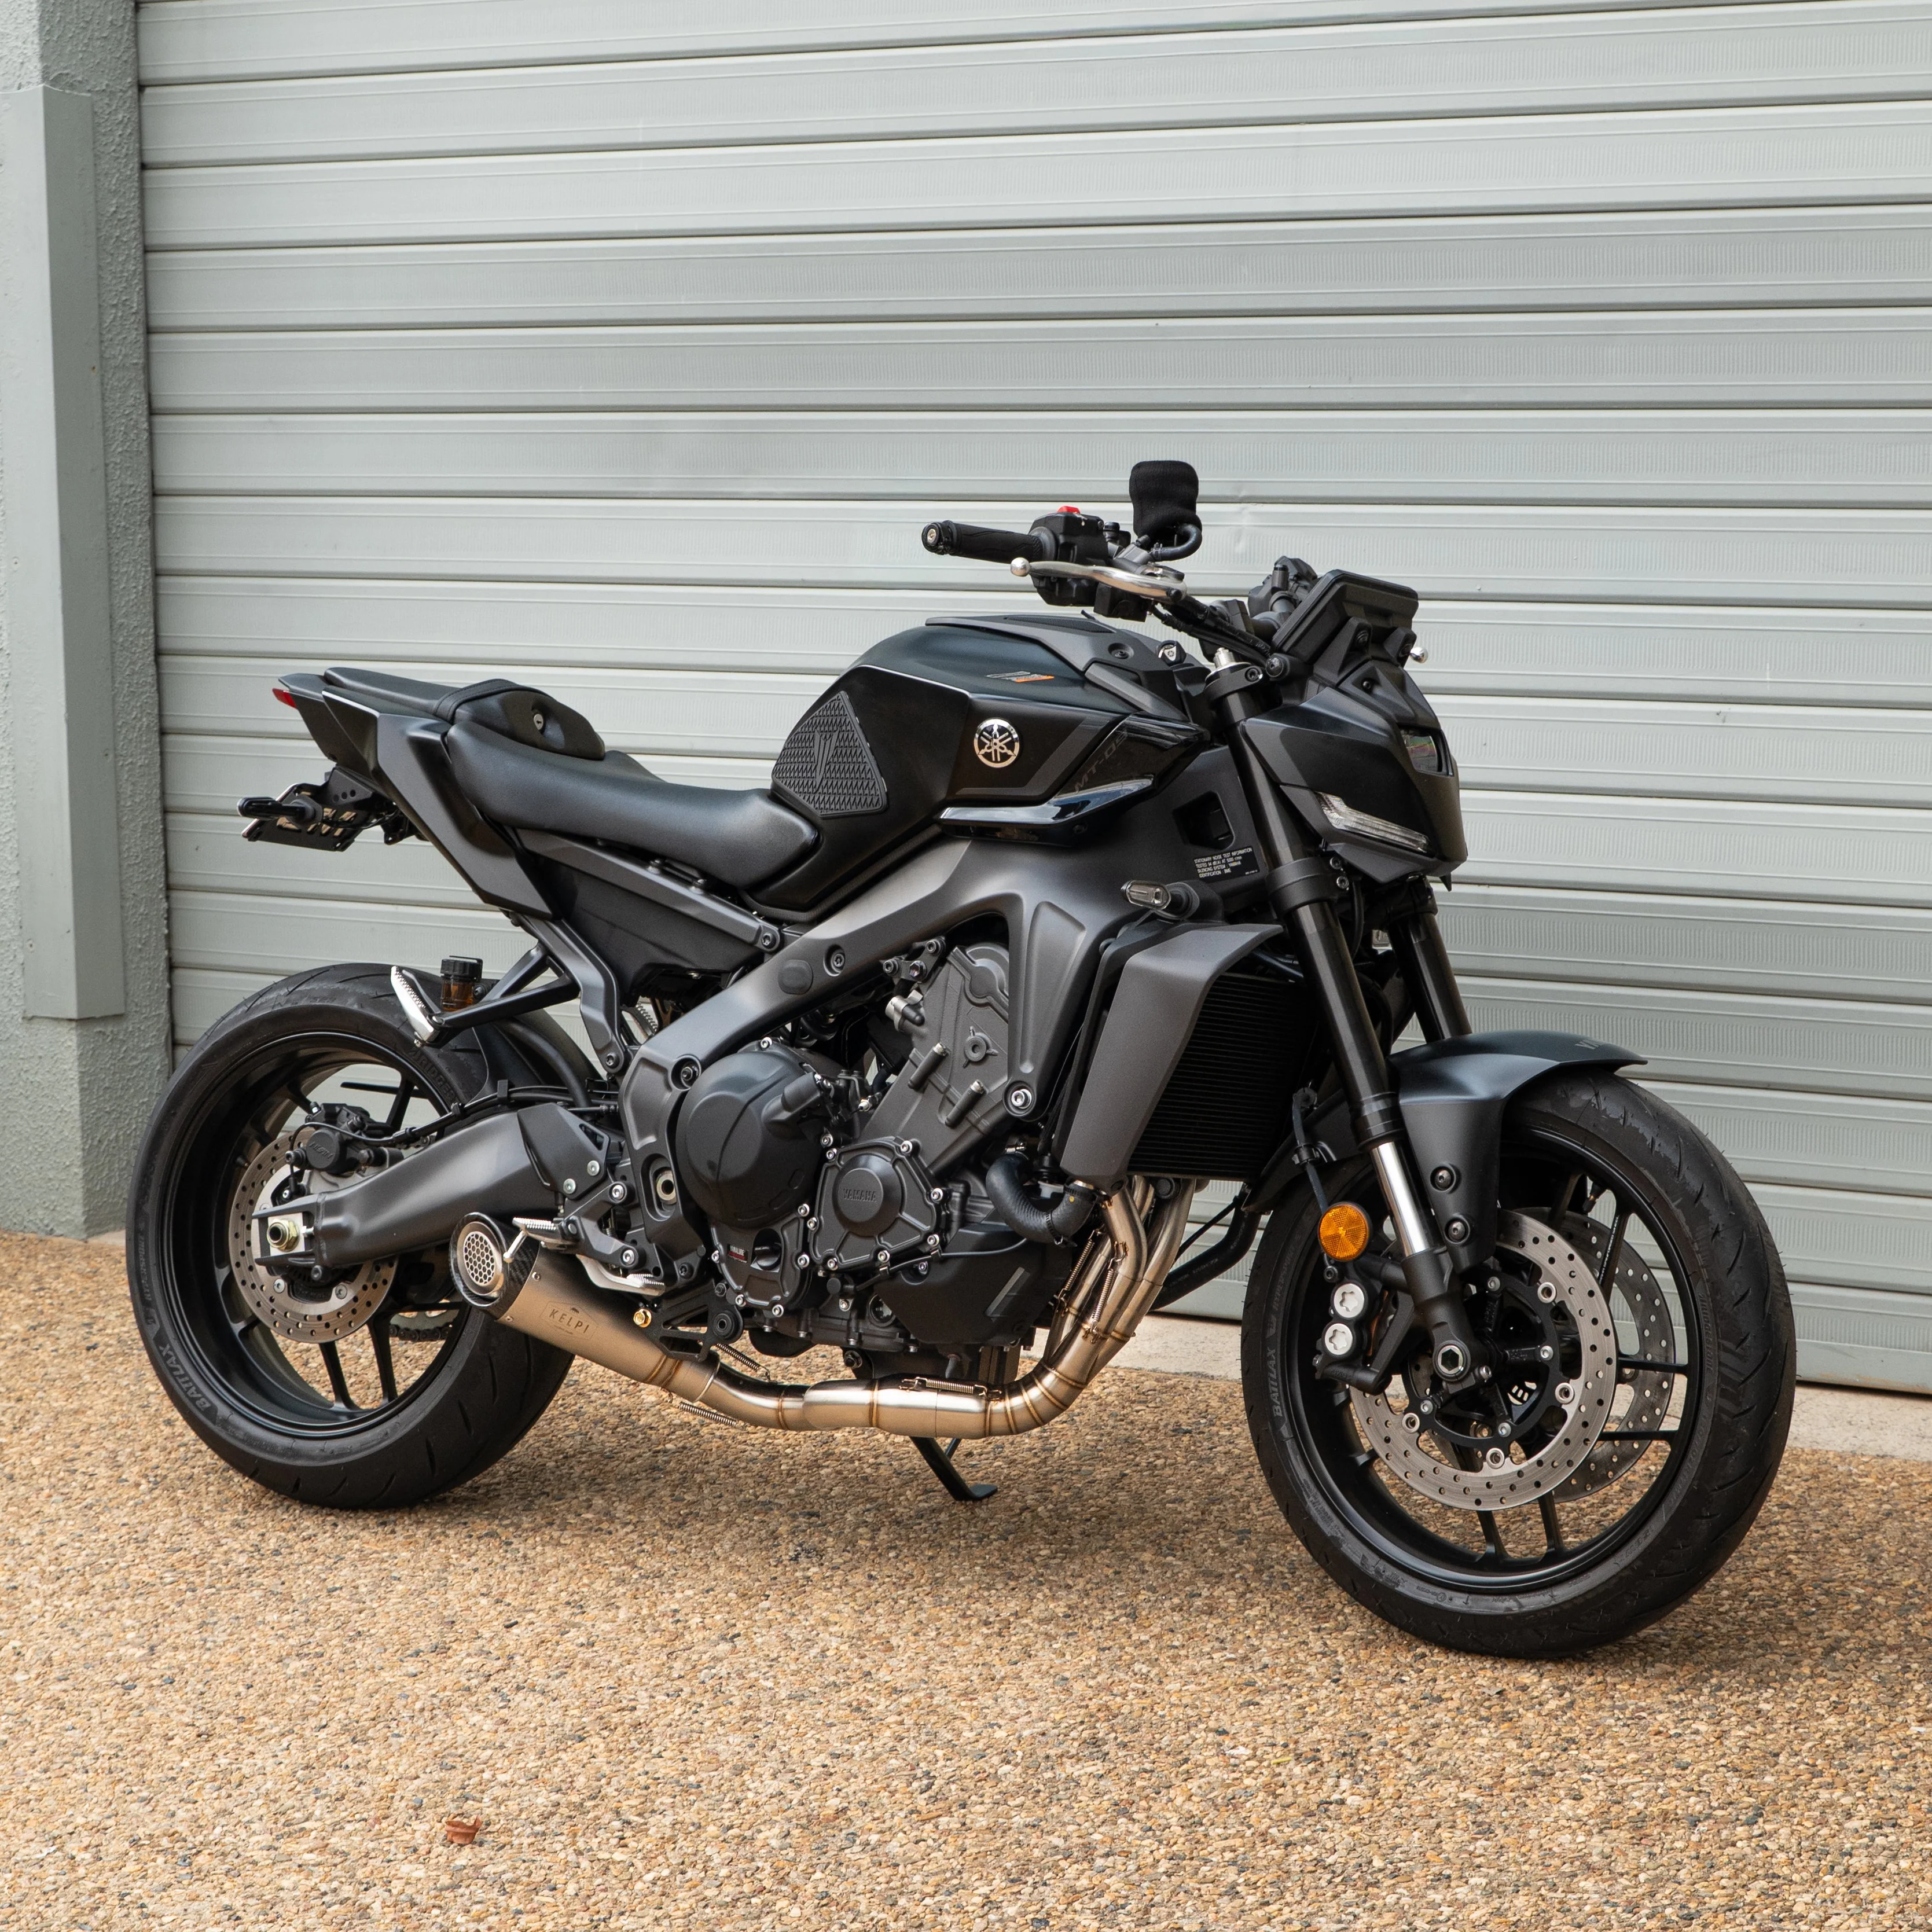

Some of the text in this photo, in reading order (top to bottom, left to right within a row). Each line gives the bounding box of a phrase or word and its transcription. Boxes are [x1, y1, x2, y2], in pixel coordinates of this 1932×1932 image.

[1232, 847, 1252, 856] INFORMATION
[843, 1188, 877, 1202] YAMAHA
[549, 1309, 589, 1334] KELPI
[159, 1343, 211, 1411] BATTLAX
[1267, 1346, 1283, 1417] BATTLAX
